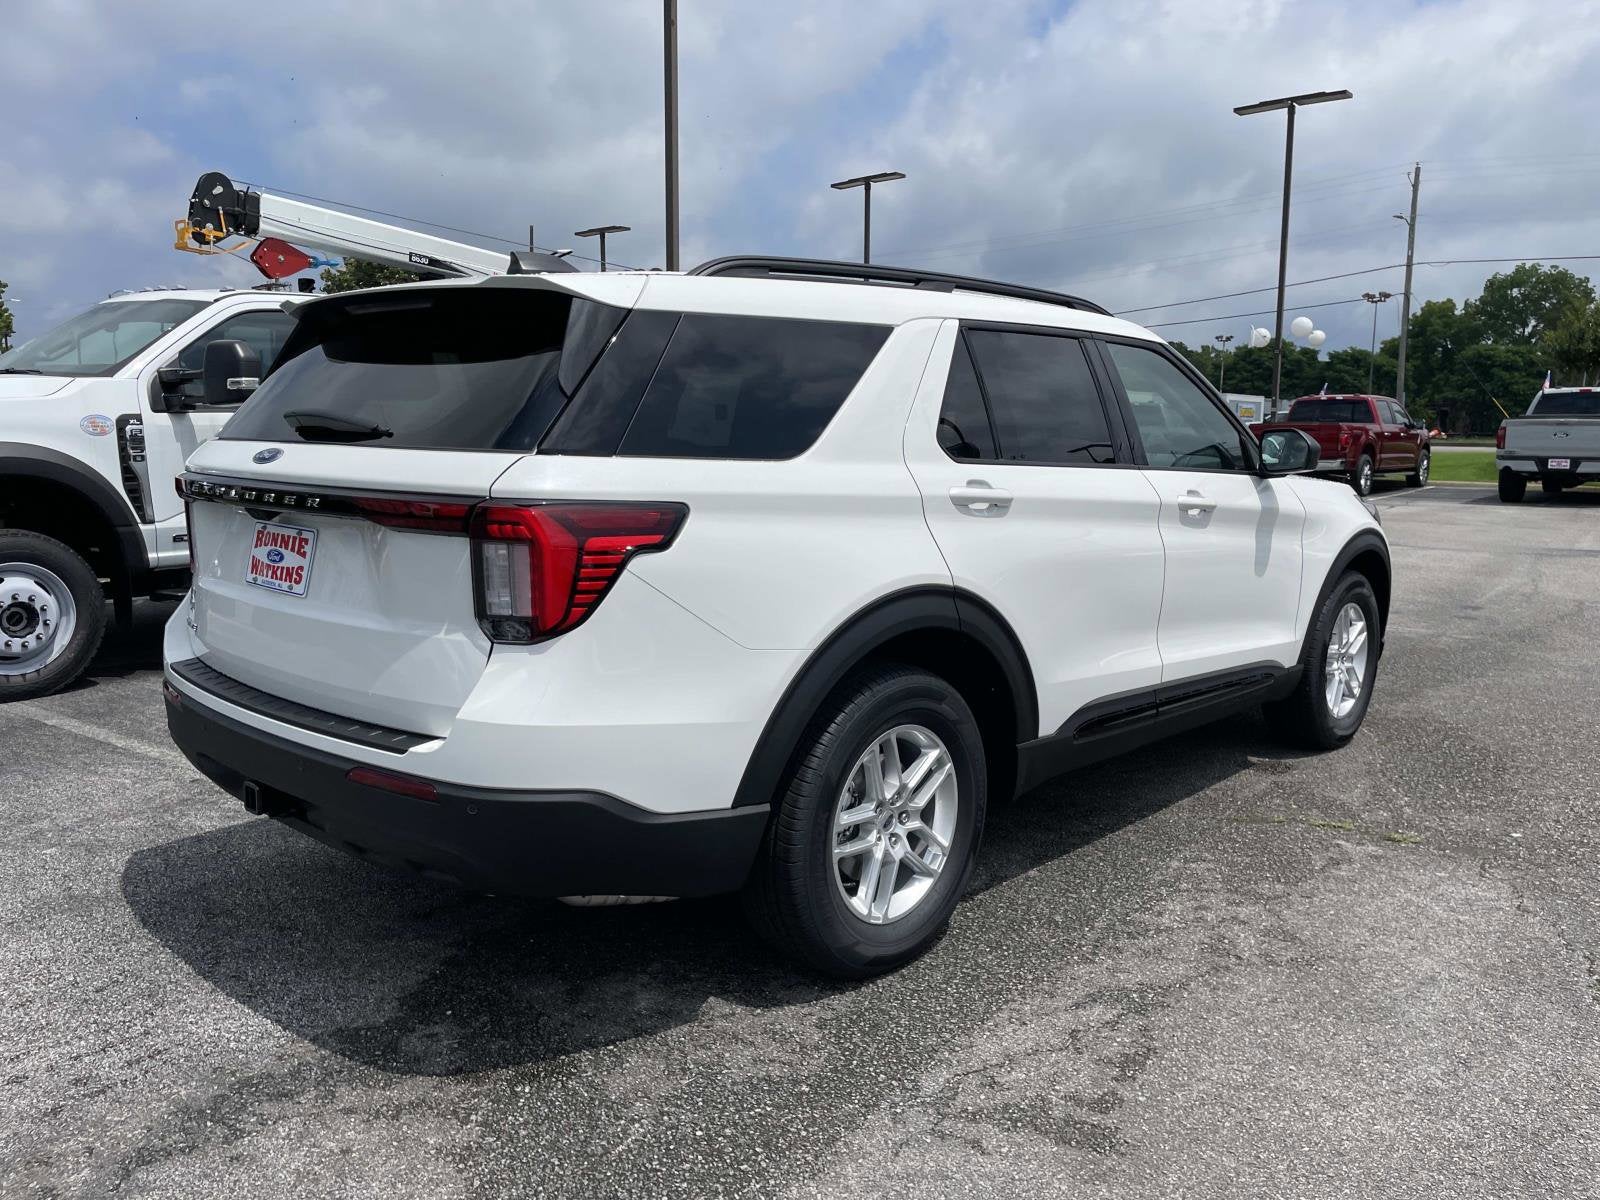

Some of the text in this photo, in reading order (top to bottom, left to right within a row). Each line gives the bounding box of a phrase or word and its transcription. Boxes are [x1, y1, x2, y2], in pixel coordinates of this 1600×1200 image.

[191, 481, 320, 508] EXPLORER
[254, 530, 309, 559] RONNIE
[251, 555, 305, 585] WATKINS
